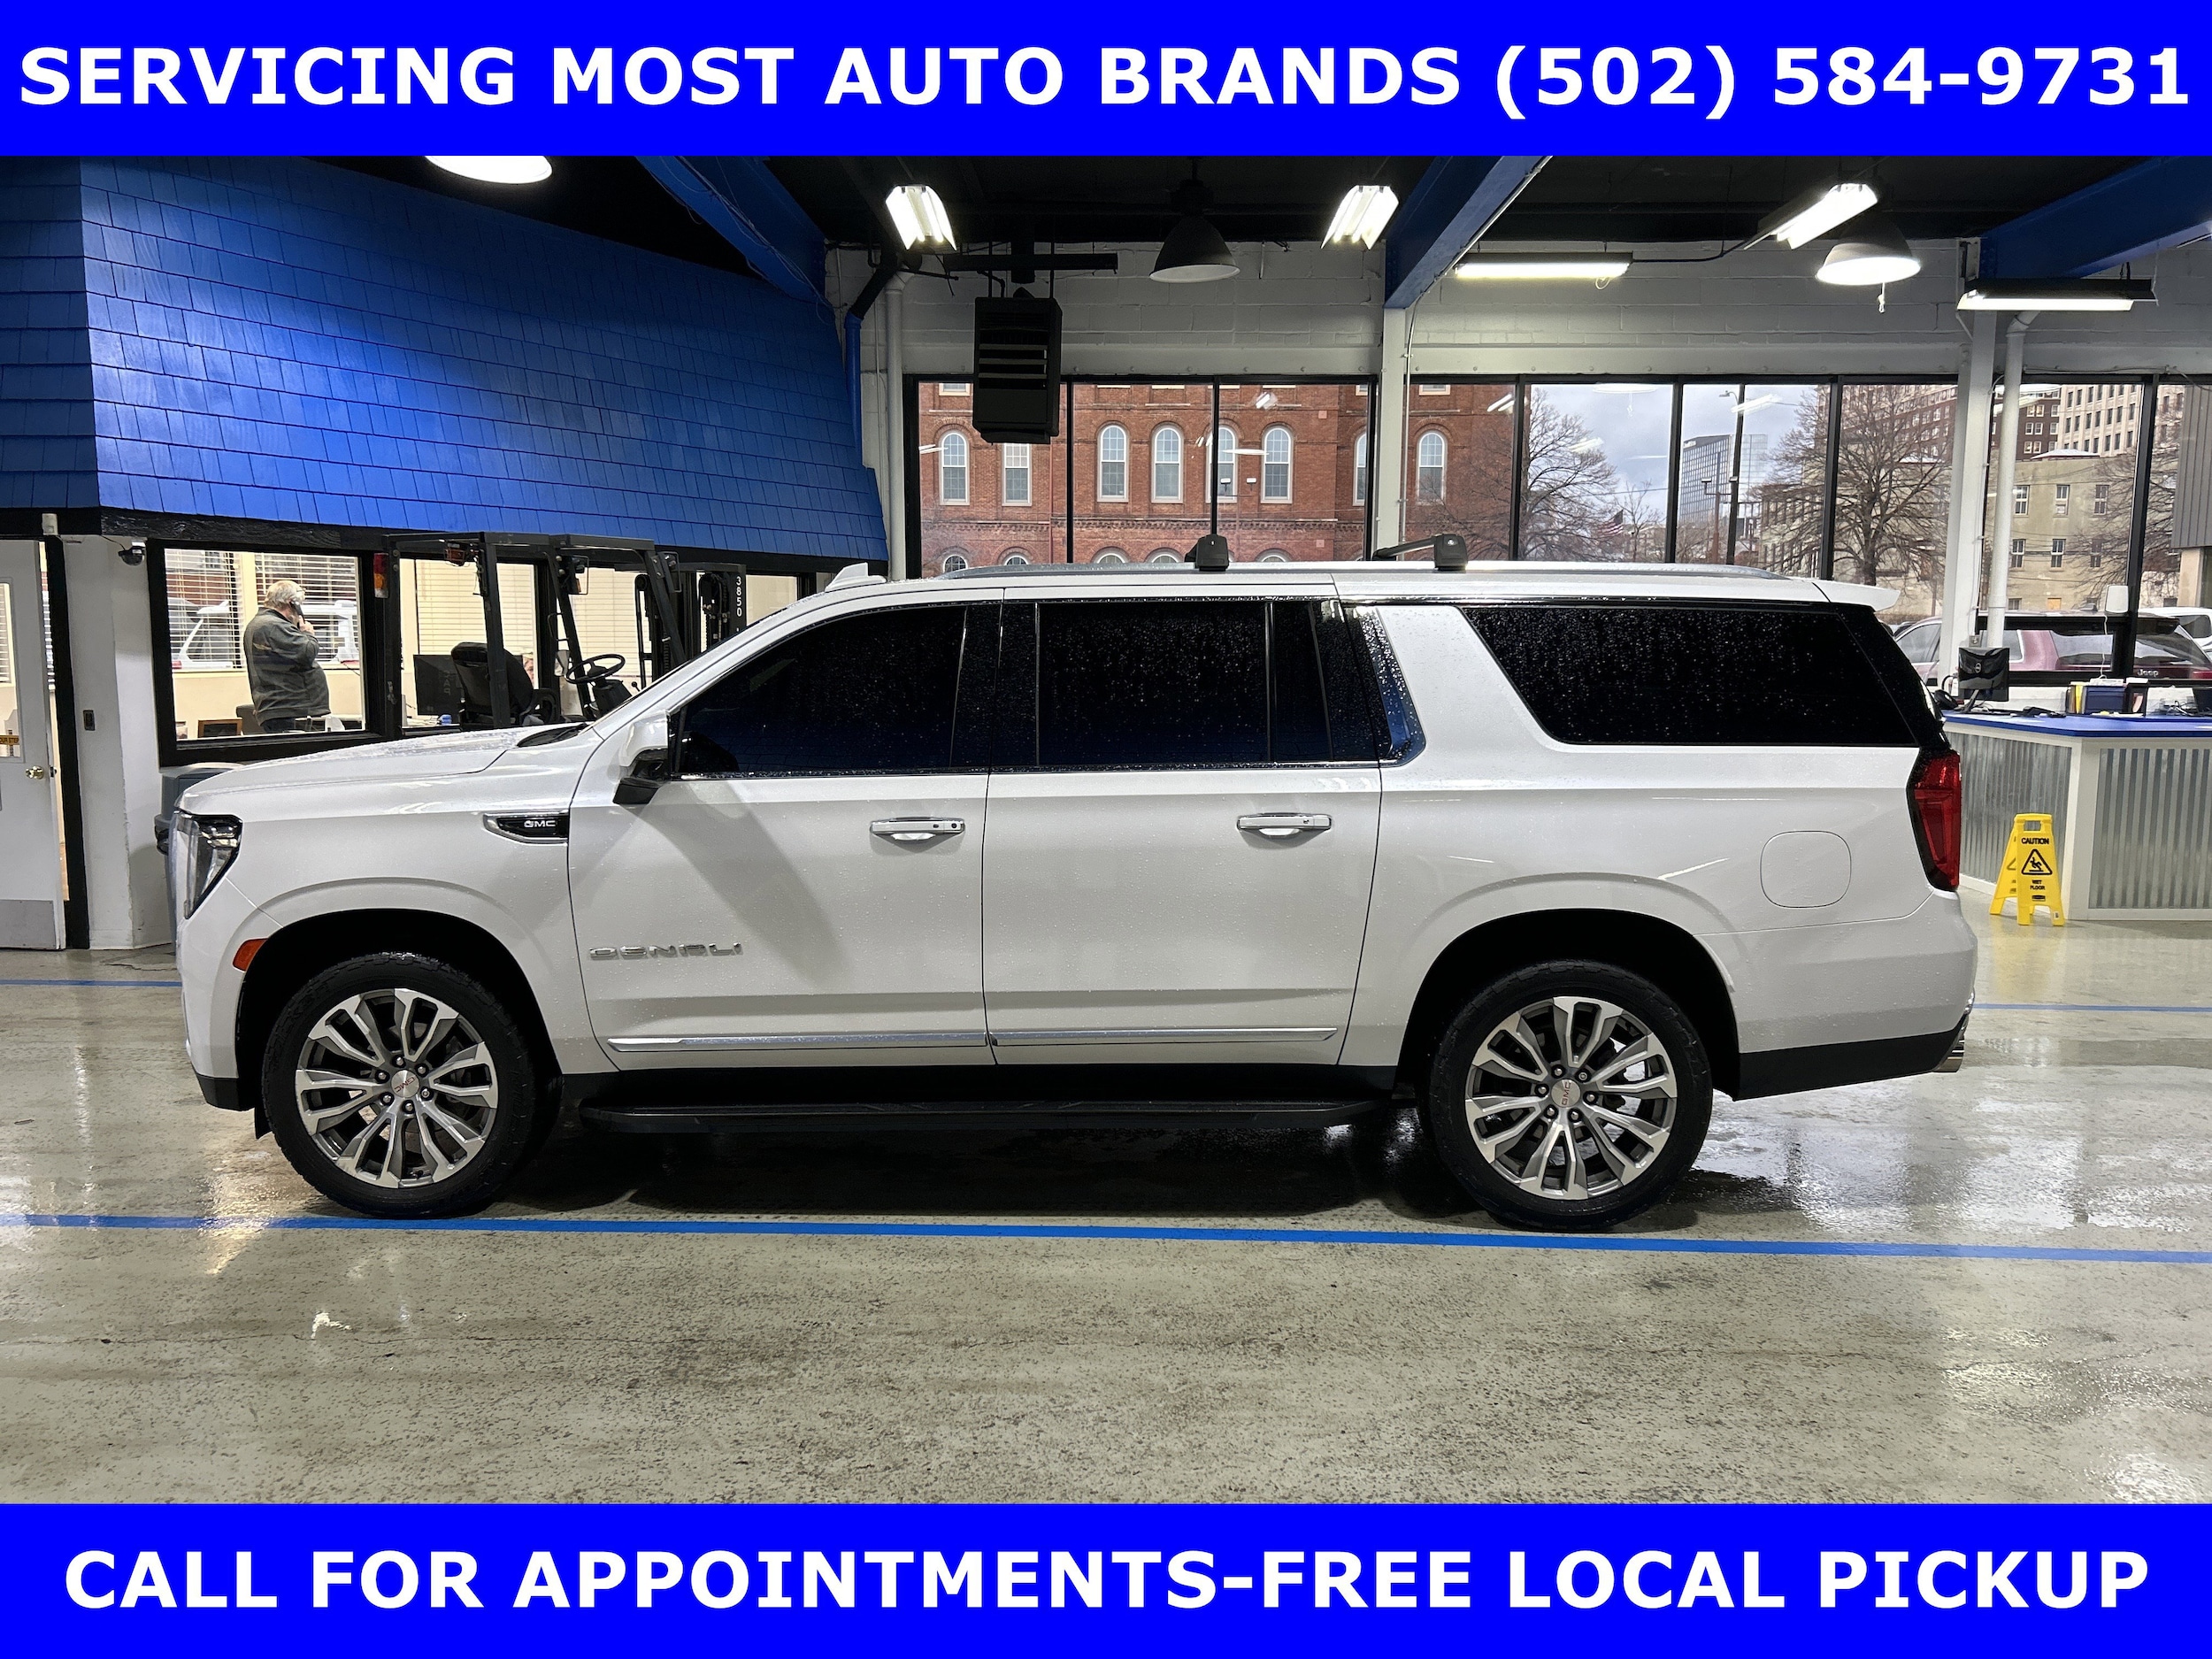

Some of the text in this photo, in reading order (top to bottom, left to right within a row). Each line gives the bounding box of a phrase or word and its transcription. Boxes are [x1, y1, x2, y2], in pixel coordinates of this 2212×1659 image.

[2137, 669, 2159, 678] Jeep
[589, 942, 742, 959] DENALI
[394, 1075, 416, 1094] GMC
[1562, 1081, 1571, 1106] GMC
